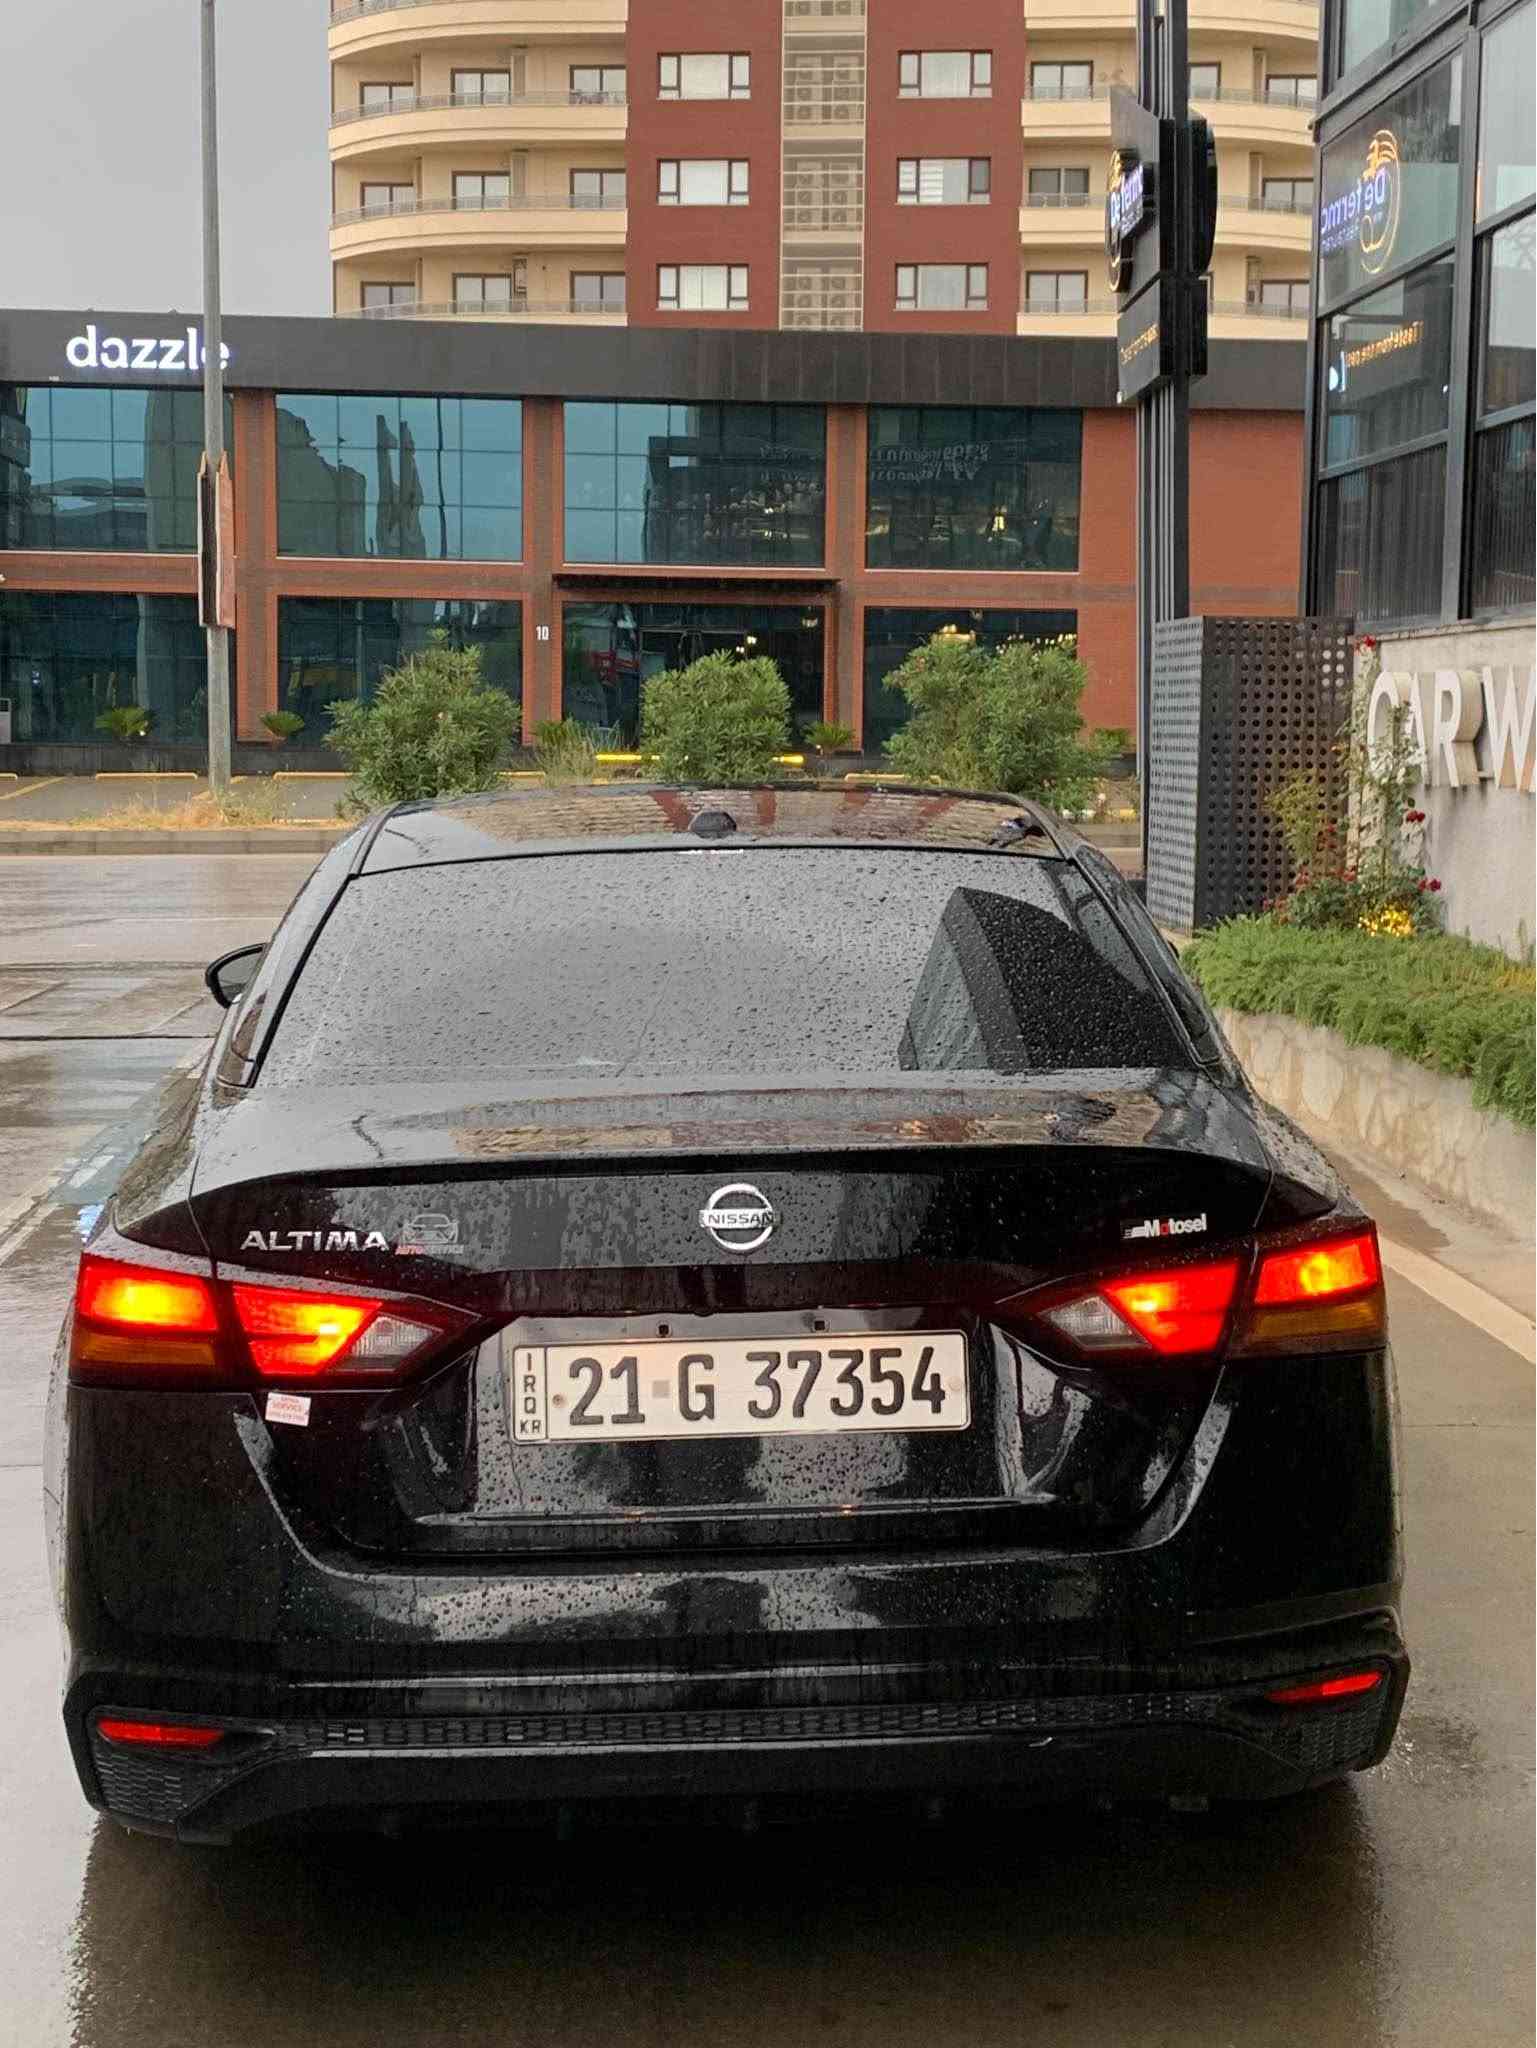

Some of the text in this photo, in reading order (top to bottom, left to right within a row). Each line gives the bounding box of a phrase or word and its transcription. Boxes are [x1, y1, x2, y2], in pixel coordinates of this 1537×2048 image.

[707, 1211, 774, 1225] NISSAN
[1144, 1213, 1207, 1238] Motosel
[240, 1230, 390, 1252] ALTIMA
[568, 1346, 947, 1426] 21 G 37354
